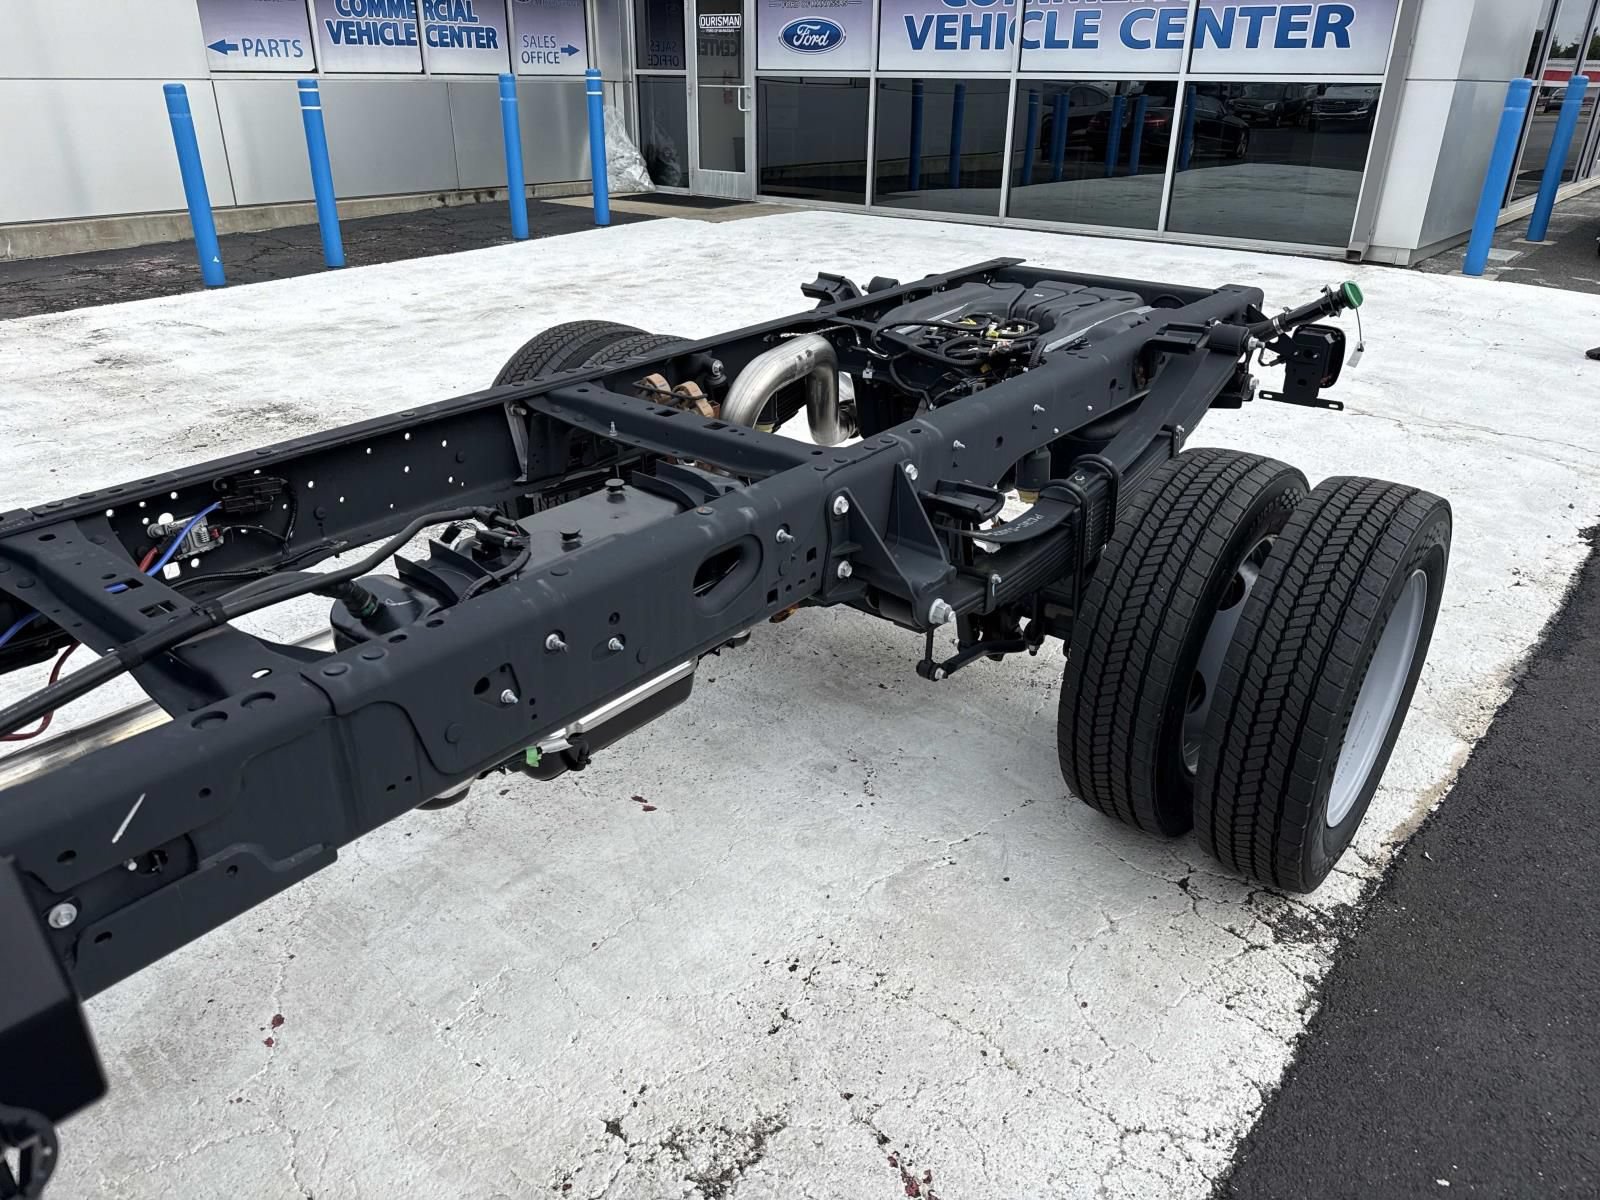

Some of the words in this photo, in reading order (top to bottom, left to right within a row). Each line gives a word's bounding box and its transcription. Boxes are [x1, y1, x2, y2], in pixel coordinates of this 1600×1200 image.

[335, 0, 479, 23] COMMERCIAL
[700, 16, 740, 27] OURISMAN
[325, 19, 418, 46] VEHICLE
[425, 25, 498, 49] CENTER
[793, 24, 830, 46] Ford
[904, 10, 1102, 50] VEHICLE
[1119, 4, 1355, 50] CENTER
[241, 38, 304, 58] PARTS
[522, 35, 557, 49] SALES
[521, 51, 560, 64] OFFICE
